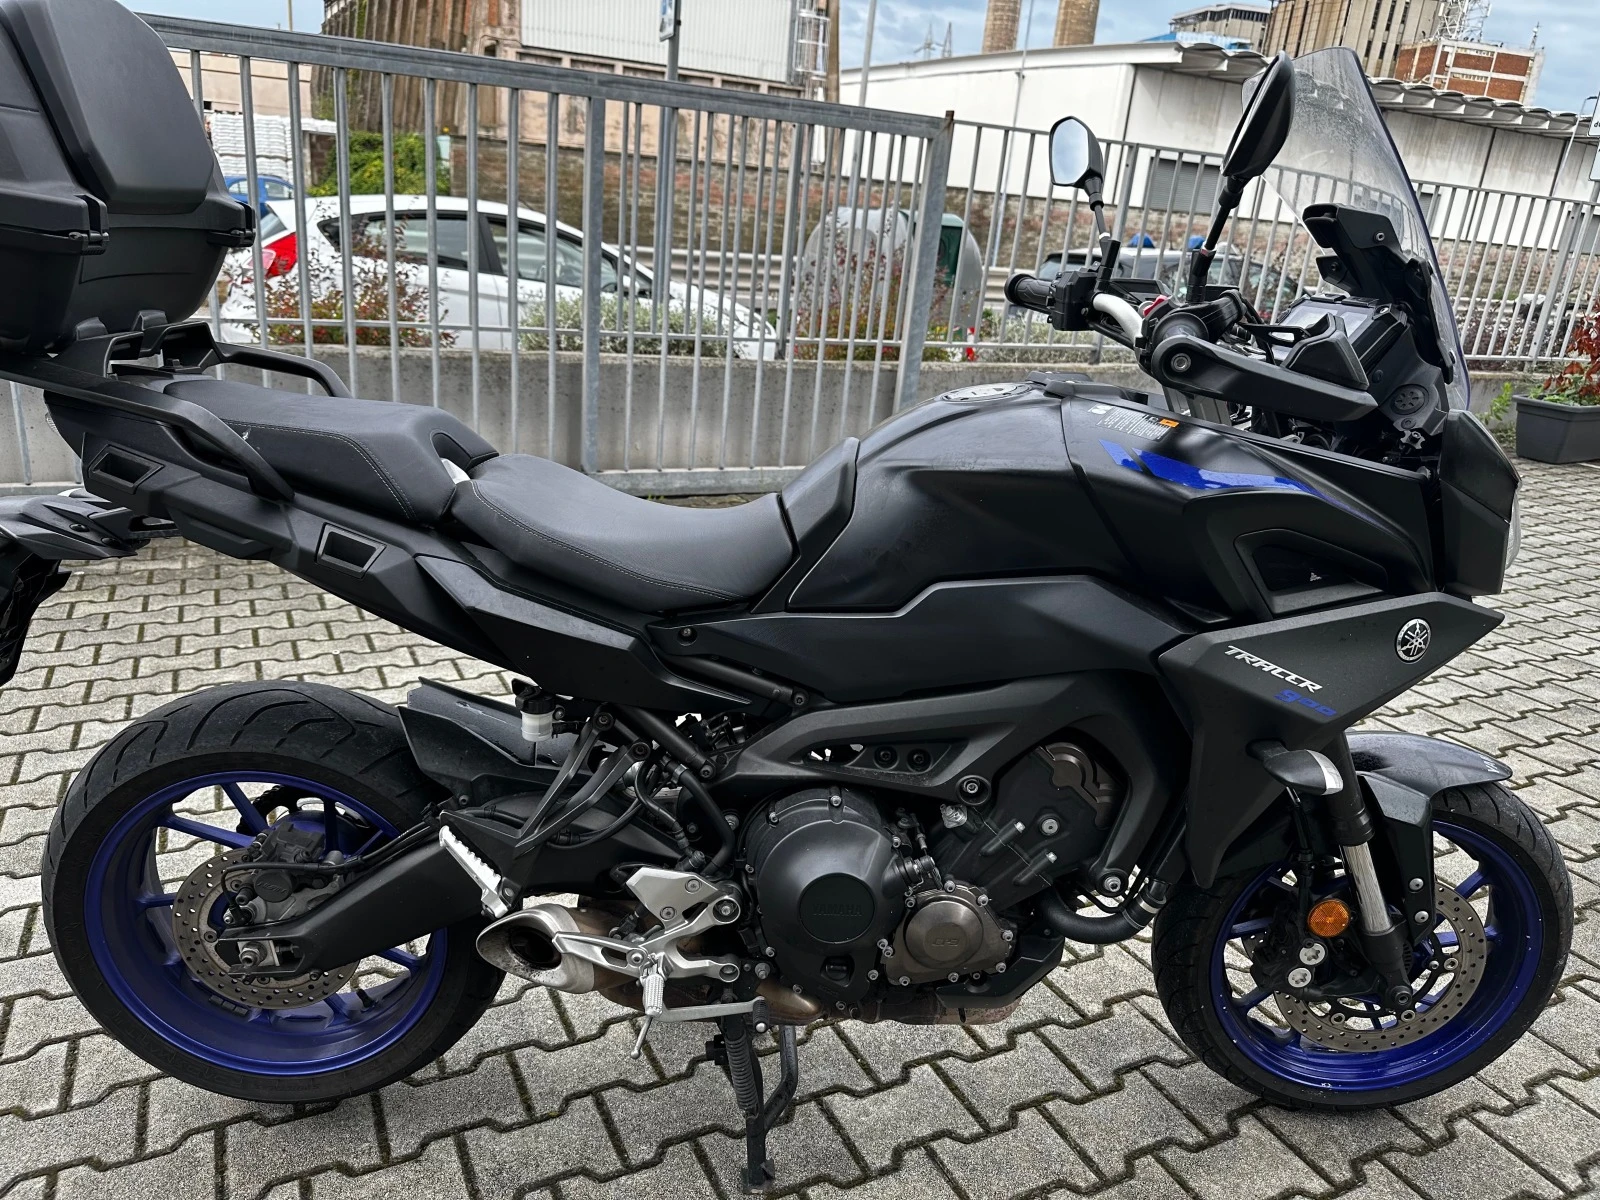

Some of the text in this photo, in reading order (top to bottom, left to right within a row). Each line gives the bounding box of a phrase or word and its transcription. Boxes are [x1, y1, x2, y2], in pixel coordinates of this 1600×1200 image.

[1224, 645, 1323, 693] TRACER
[1273, 689, 1337, 717] 900
[811, 903, 864, 917] YAMAHA
